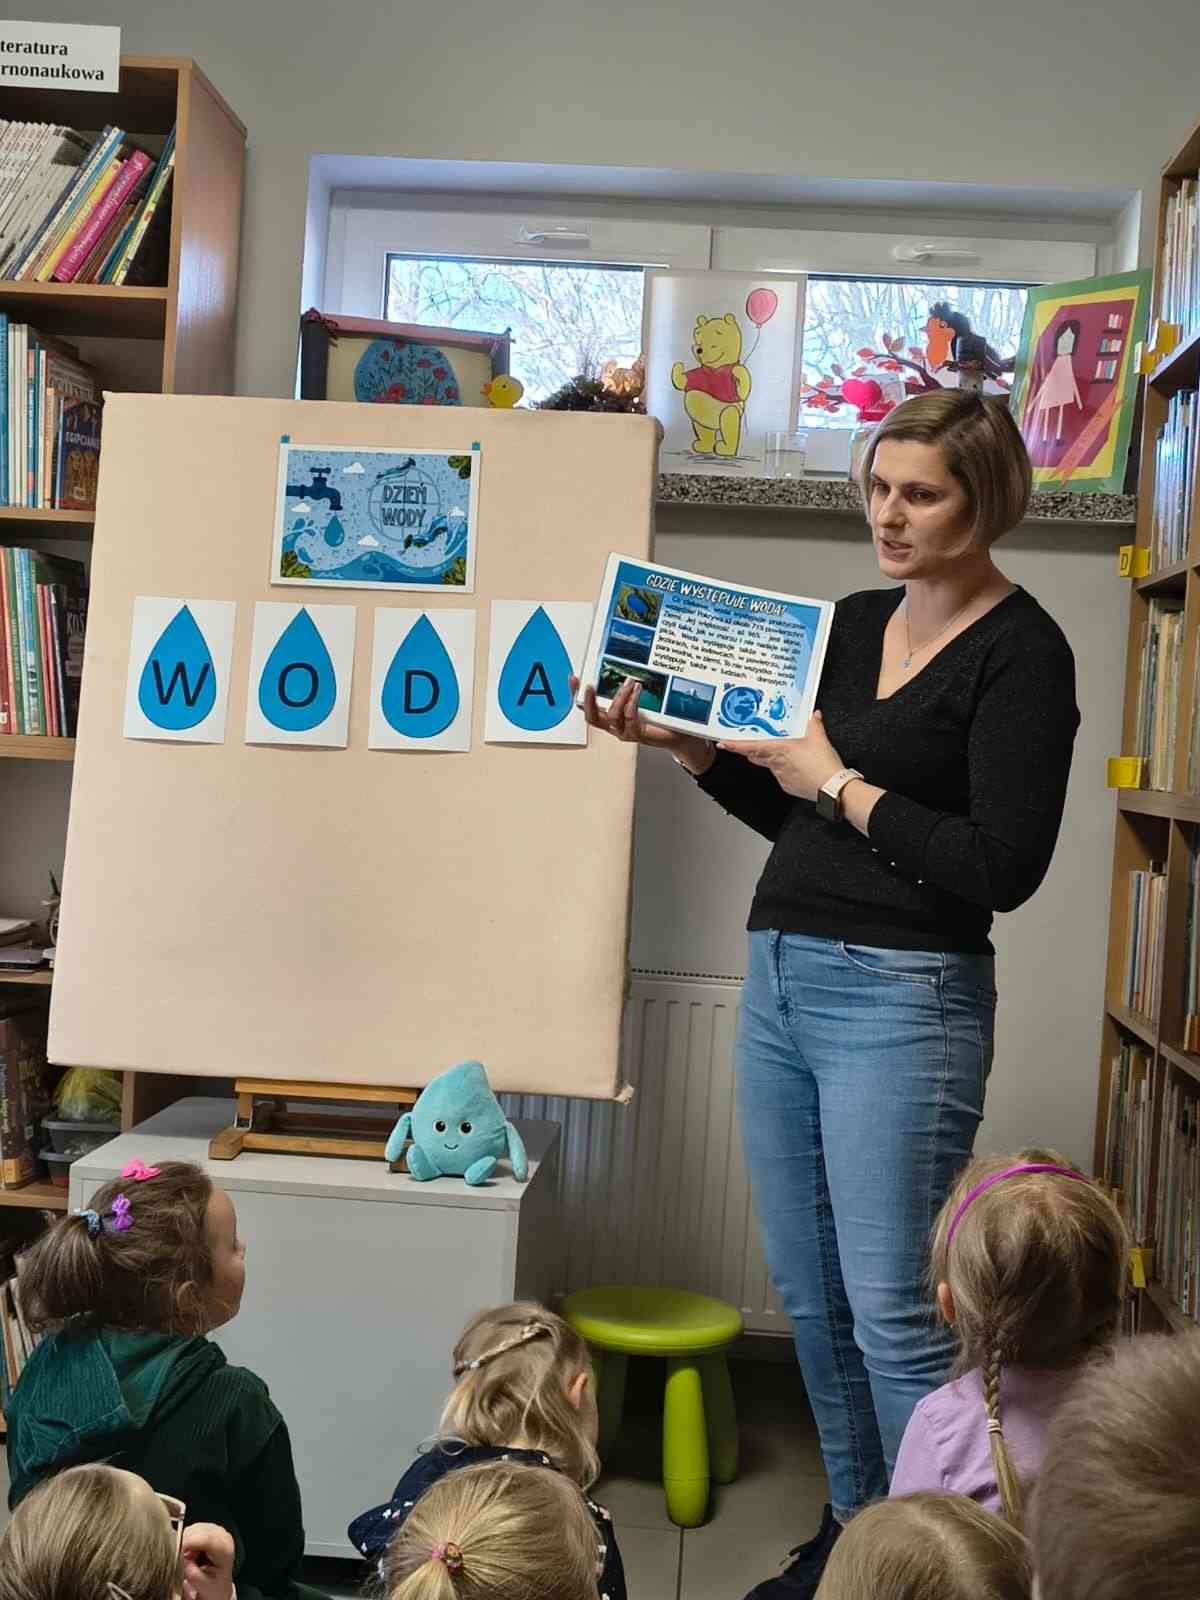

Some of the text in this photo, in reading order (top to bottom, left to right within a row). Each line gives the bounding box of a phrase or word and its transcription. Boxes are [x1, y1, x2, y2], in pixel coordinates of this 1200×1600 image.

[384, 482, 427, 504] DZIEŃ
[382, 508, 426, 527] WODY
[646, 574, 680, 591] GDZIE
[153, 660, 555, 714] W O D A
